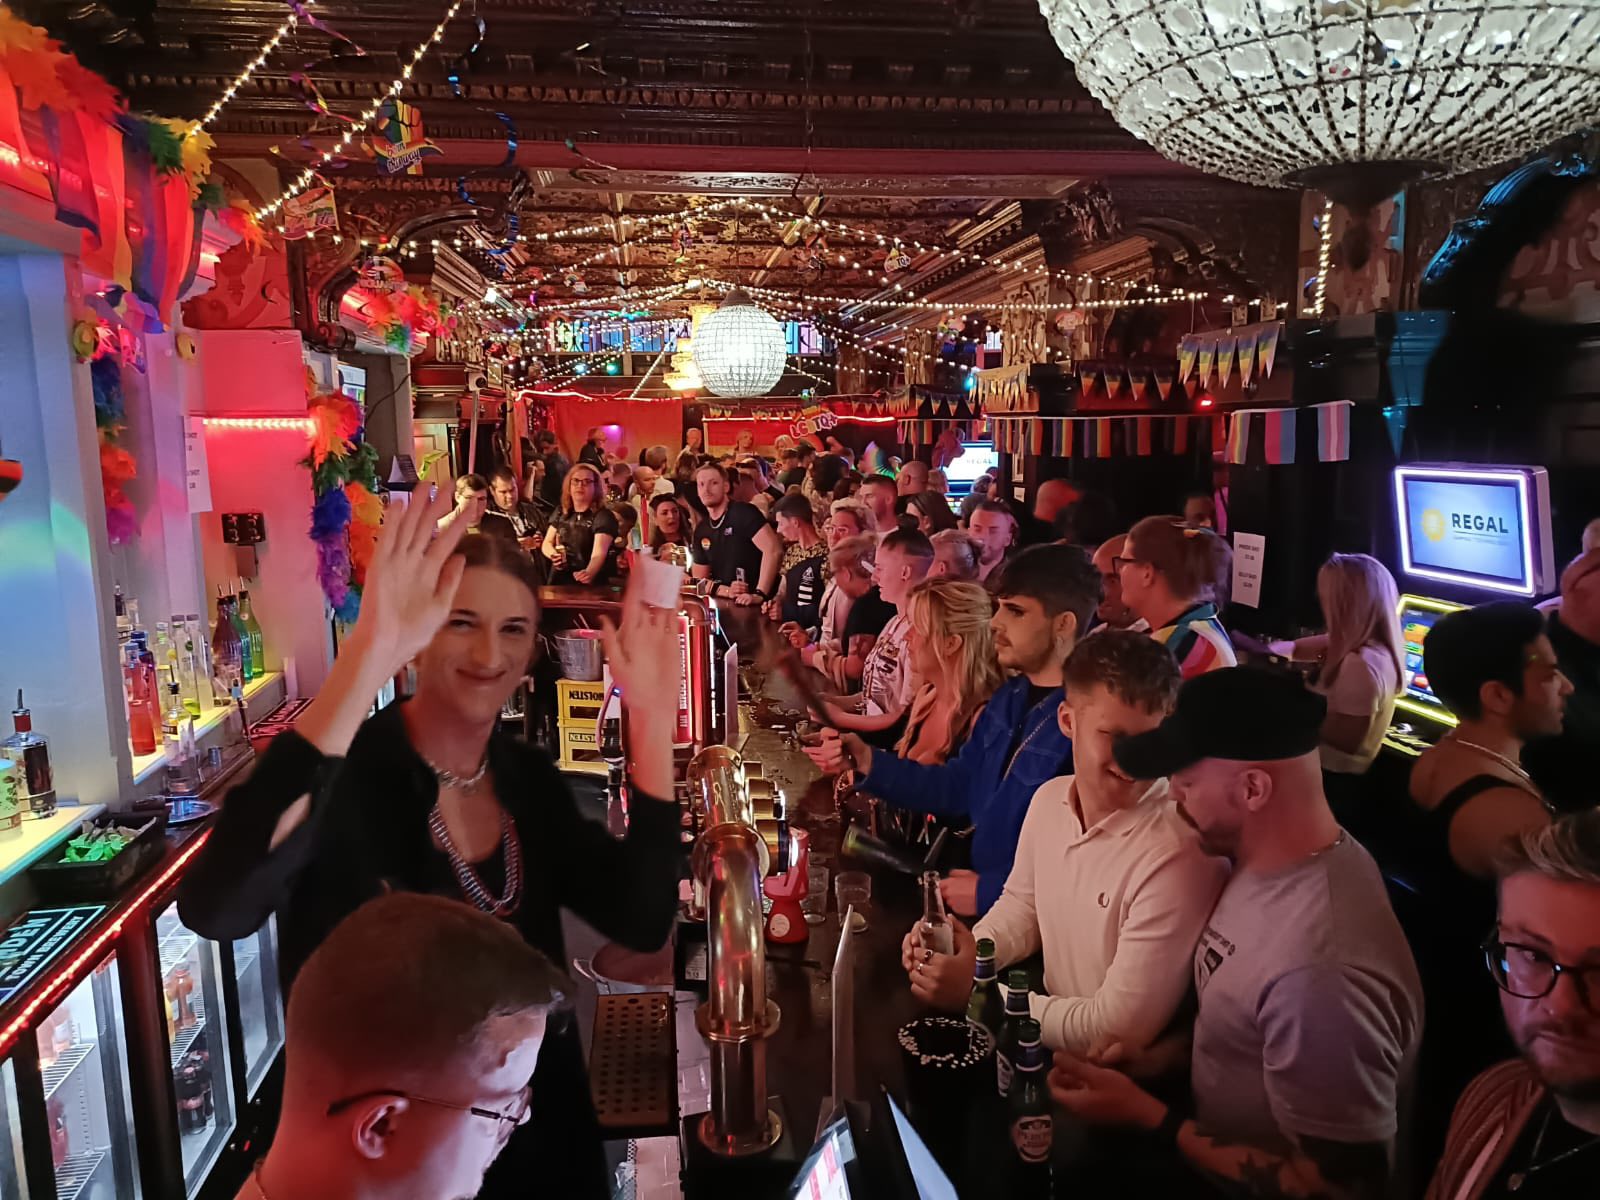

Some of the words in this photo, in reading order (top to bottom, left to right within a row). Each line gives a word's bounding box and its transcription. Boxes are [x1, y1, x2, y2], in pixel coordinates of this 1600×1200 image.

[1451, 513, 1509, 534] REGAL
[570, 732, 597, 742] LSTEN
[4, 953, 44, 980] TOWN
[35, 915, 85, 953] BREWERY
